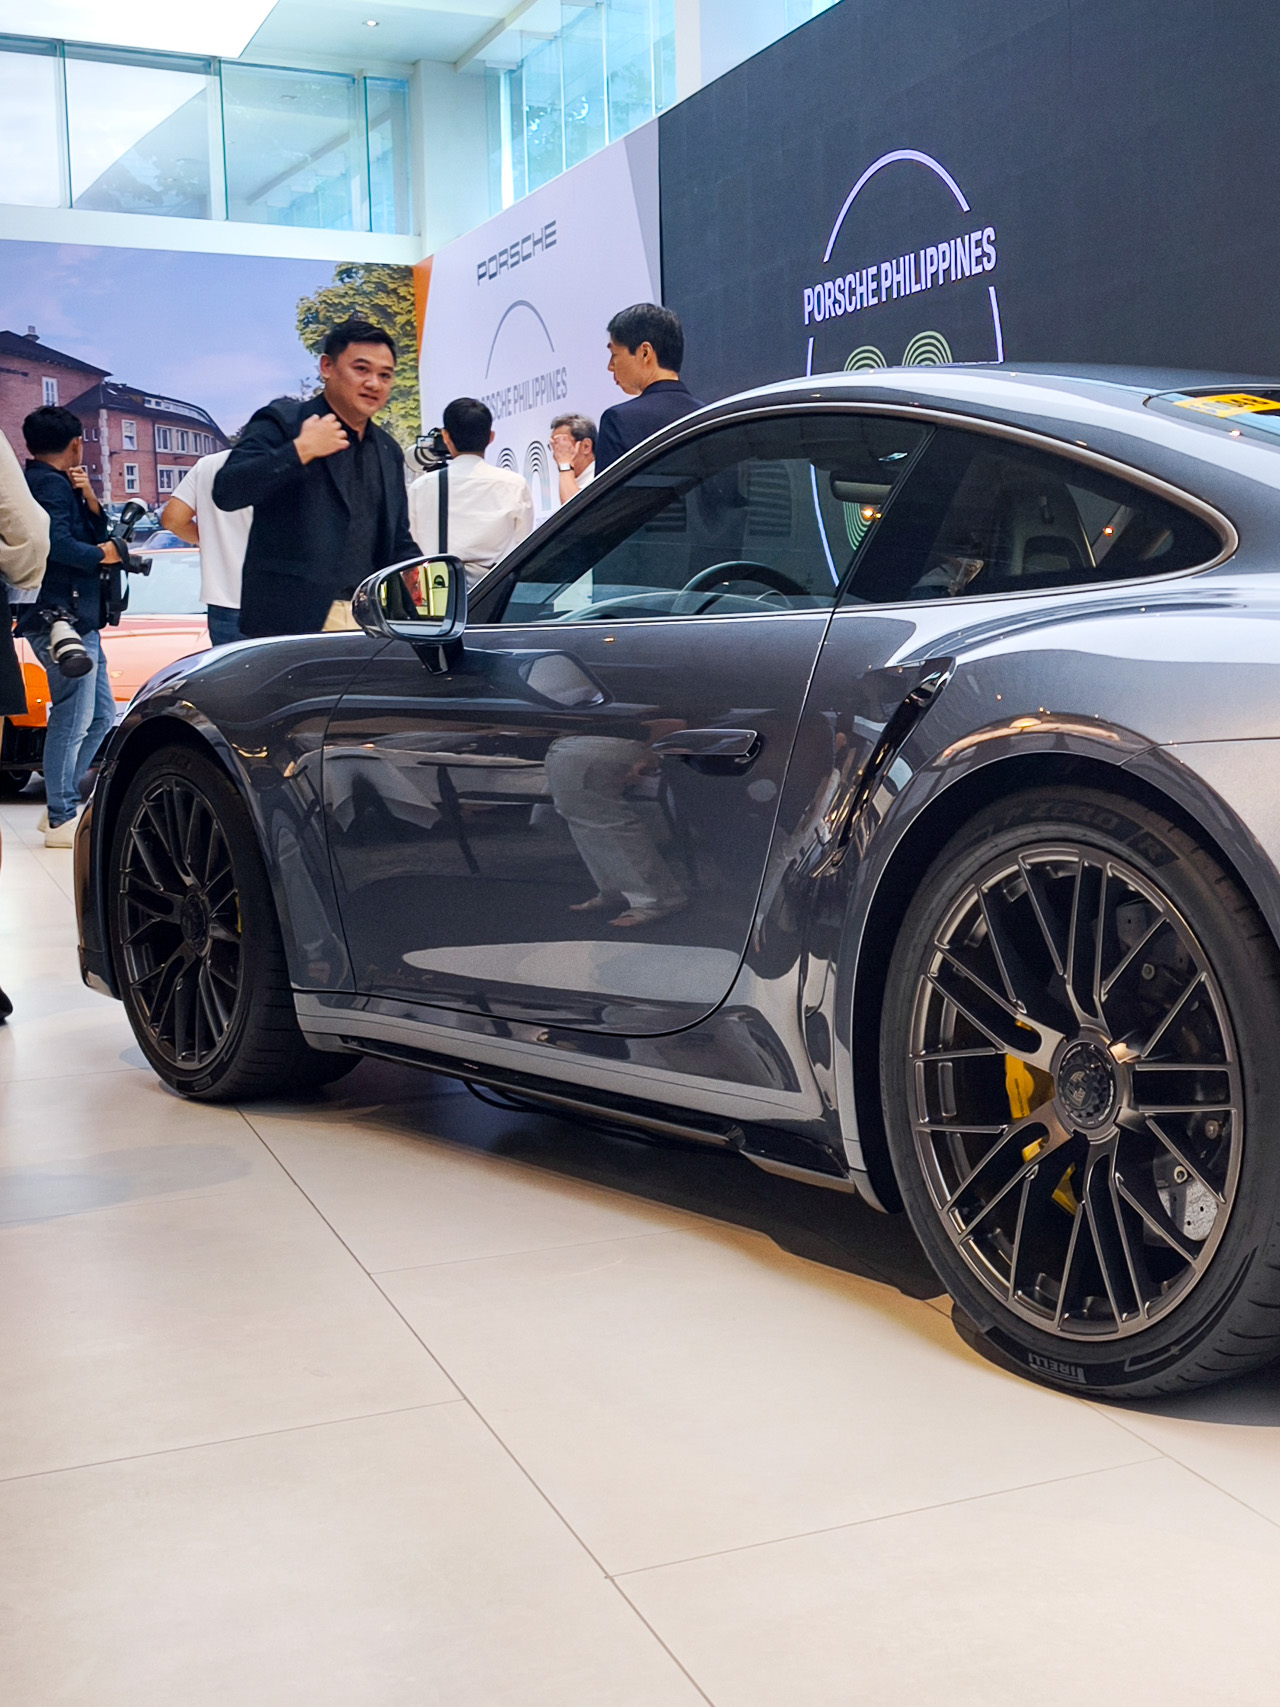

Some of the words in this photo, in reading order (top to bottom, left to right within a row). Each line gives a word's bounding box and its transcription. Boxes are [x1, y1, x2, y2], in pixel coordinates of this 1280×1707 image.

[476, 219, 557, 287] PORSCHE
[803, 265, 879, 326] PORSCHE
[880, 226, 997, 303] PHILIPPINES
[512, 366, 568, 414] PHILIPPINES
[1028, 1352, 1087, 1384] PIRELLI
